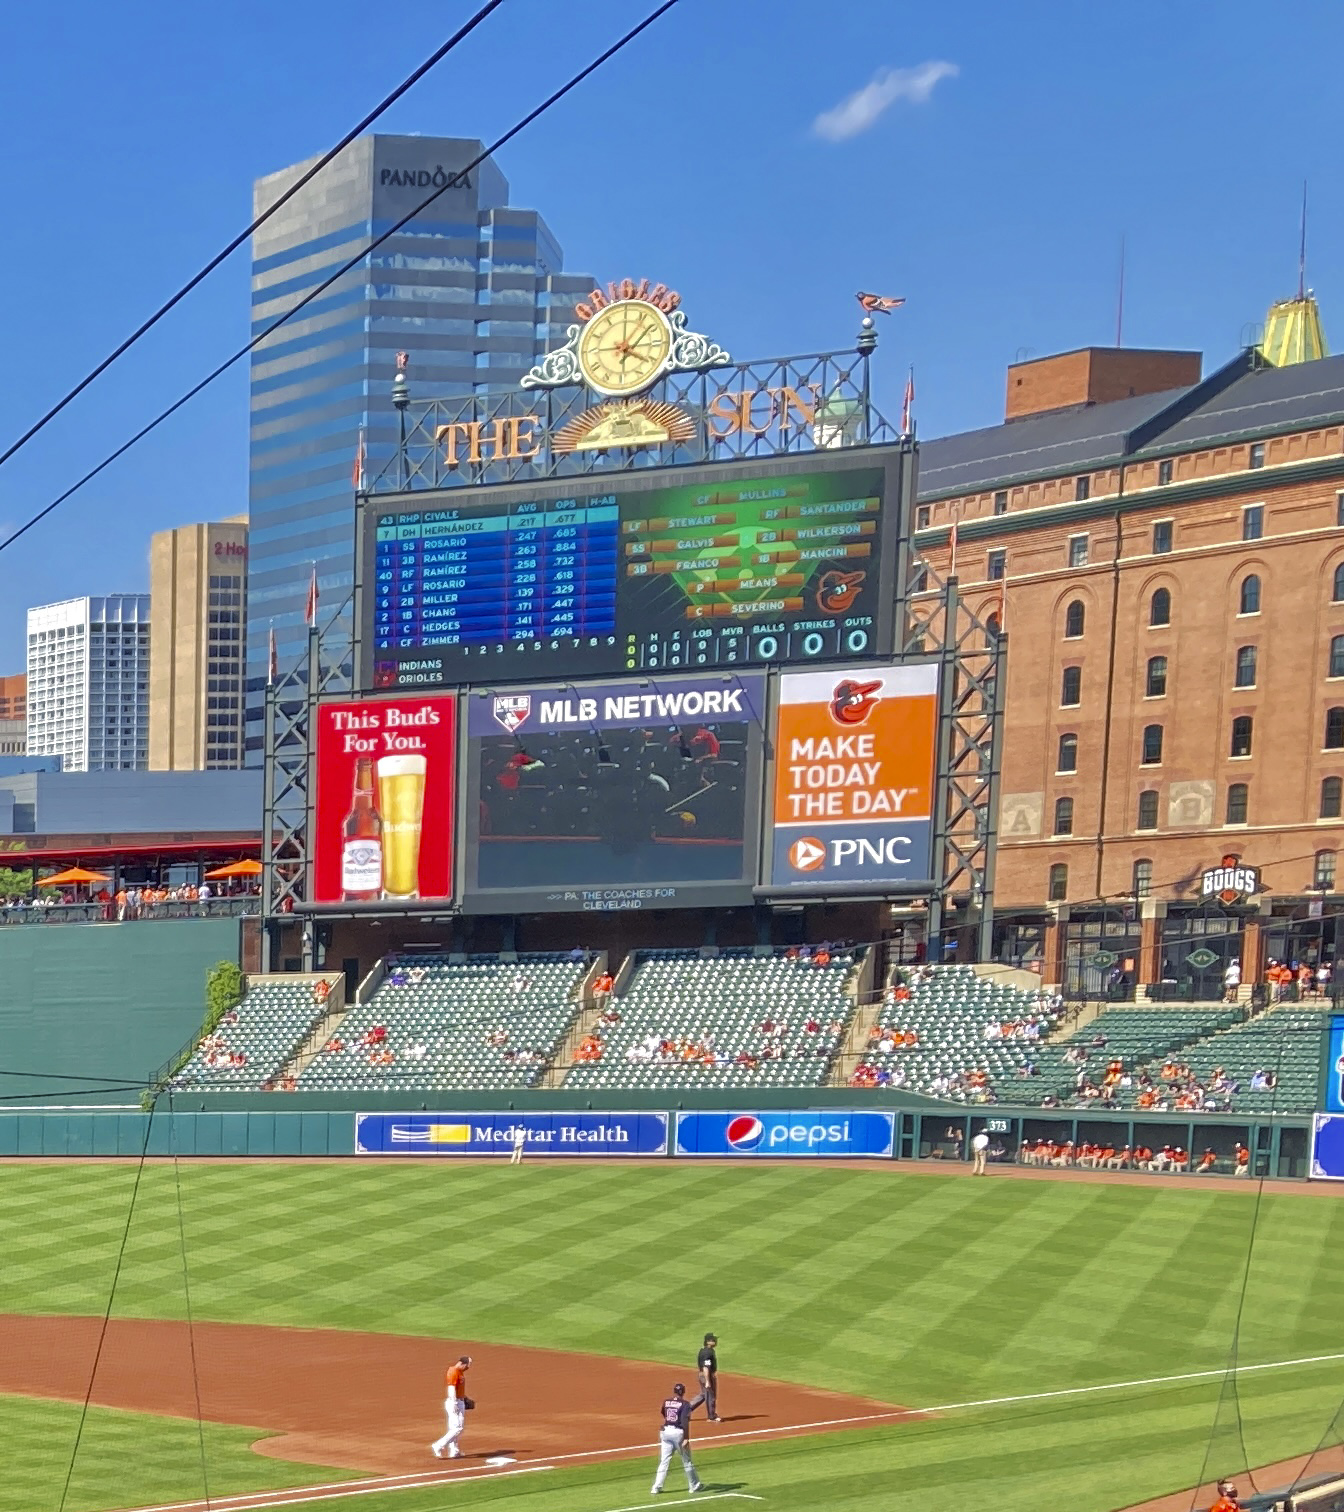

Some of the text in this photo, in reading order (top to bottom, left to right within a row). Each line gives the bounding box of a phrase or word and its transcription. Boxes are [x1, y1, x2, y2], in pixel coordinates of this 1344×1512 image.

[575, 278, 682, 321] ORIOLES
[436, 383, 822, 465] THE SUN
[739, 488, 787, 501] MULLINS
[424, 500, 576, 521] CIVALE AVG OPS
[668, 501, 866, 528] STEWART SANTANDER
[424, 521, 484, 536] HERNÁNDEZ
[677, 524, 861, 549] GALVIS WILKERSON
[214, 541, 223, 555] 2
[424, 537, 467, 549] ROSARIO
[676, 547, 848, 570] FRANCO MANCINI
[423, 579, 466, 591] ROSARIO
[740, 577, 778, 588] MEANS
[422, 594, 458, 605] MILLER
[731, 601, 785, 614] SEVERINO
[422, 608, 456, 619] CHANG
[422, 621, 461, 632] HEDGES
[752, 623, 785, 634] BALLS
[793, 619, 836, 631] STRIKES
[844, 616, 873, 628] OUTS
[422, 635, 460, 646] ZIMMER
[398, 629, 868, 671] INDIANS 0 0 0
[398, 673, 443, 684] ORIOLES
[540, 689, 744, 723] MLB NETWORK
[331, 706, 440, 730] This Bud's
[343, 732, 426, 752] For You.
[790, 734, 876, 761] MAKE
[788, 762, 882, 789] TODAY
[788, 792, 844, 817] THE
[830, 836, 912, 867] PNC
[582, 891, 602, 900] THE
[603, 889, 652, 900] COACHES
[654, 888, 675, 898] FOR
[583, 899, 642, 910] CLEVELAND
[474, 1125, 630, 1142] Medtar Health
[989, 1120, 1007, 1131] 373
[769, 1122, 852, 1148] pepsi
